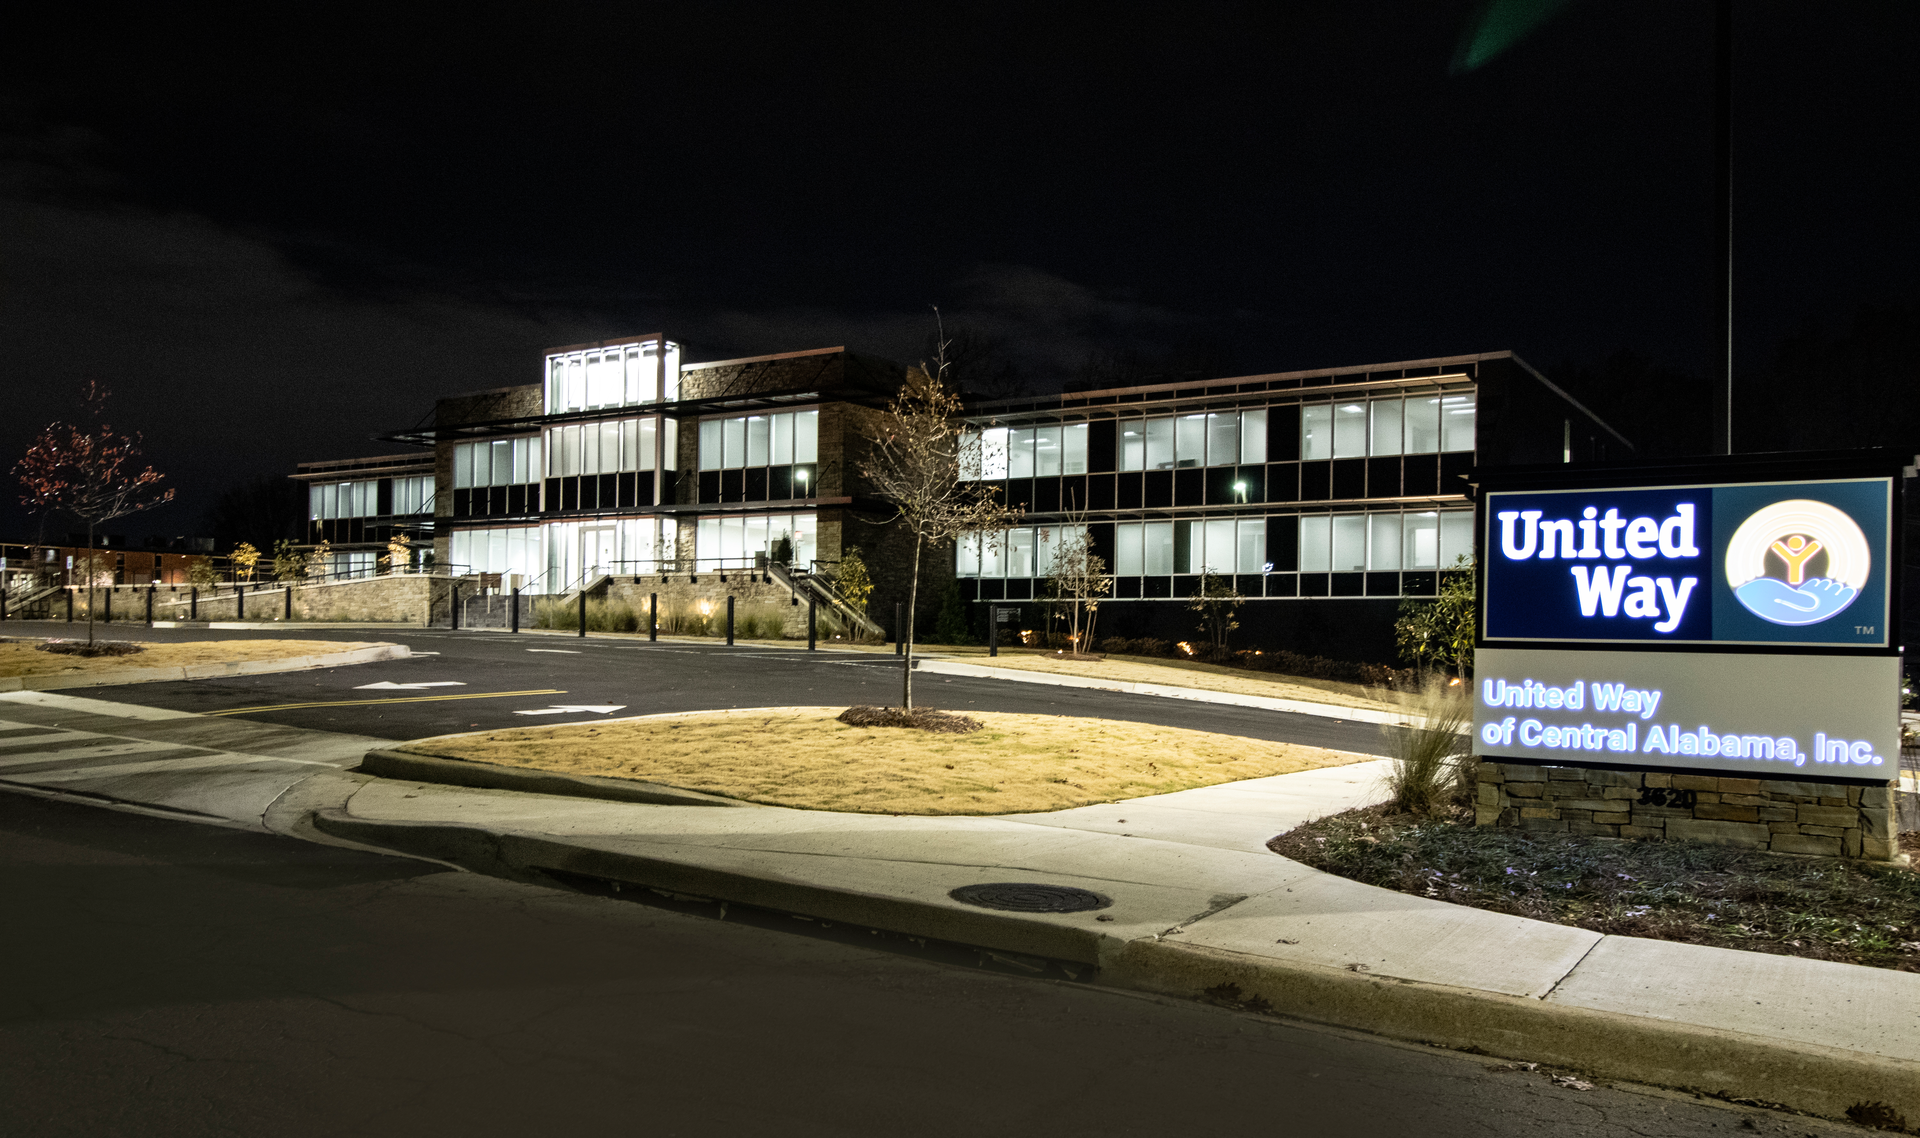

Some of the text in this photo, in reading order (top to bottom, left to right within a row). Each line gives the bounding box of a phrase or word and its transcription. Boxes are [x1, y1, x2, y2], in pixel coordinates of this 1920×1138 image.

[1498, 503, 1699, 560] United
[1571, 565, 1697, 633] Way
[1854, 625, 1875, 635] TM
[1483, 679, 1661, 719] United Way
[1482, 717, 1883, 766] of Central Alabama, Inc.
[1637, 786, 1697, 809] 3620
